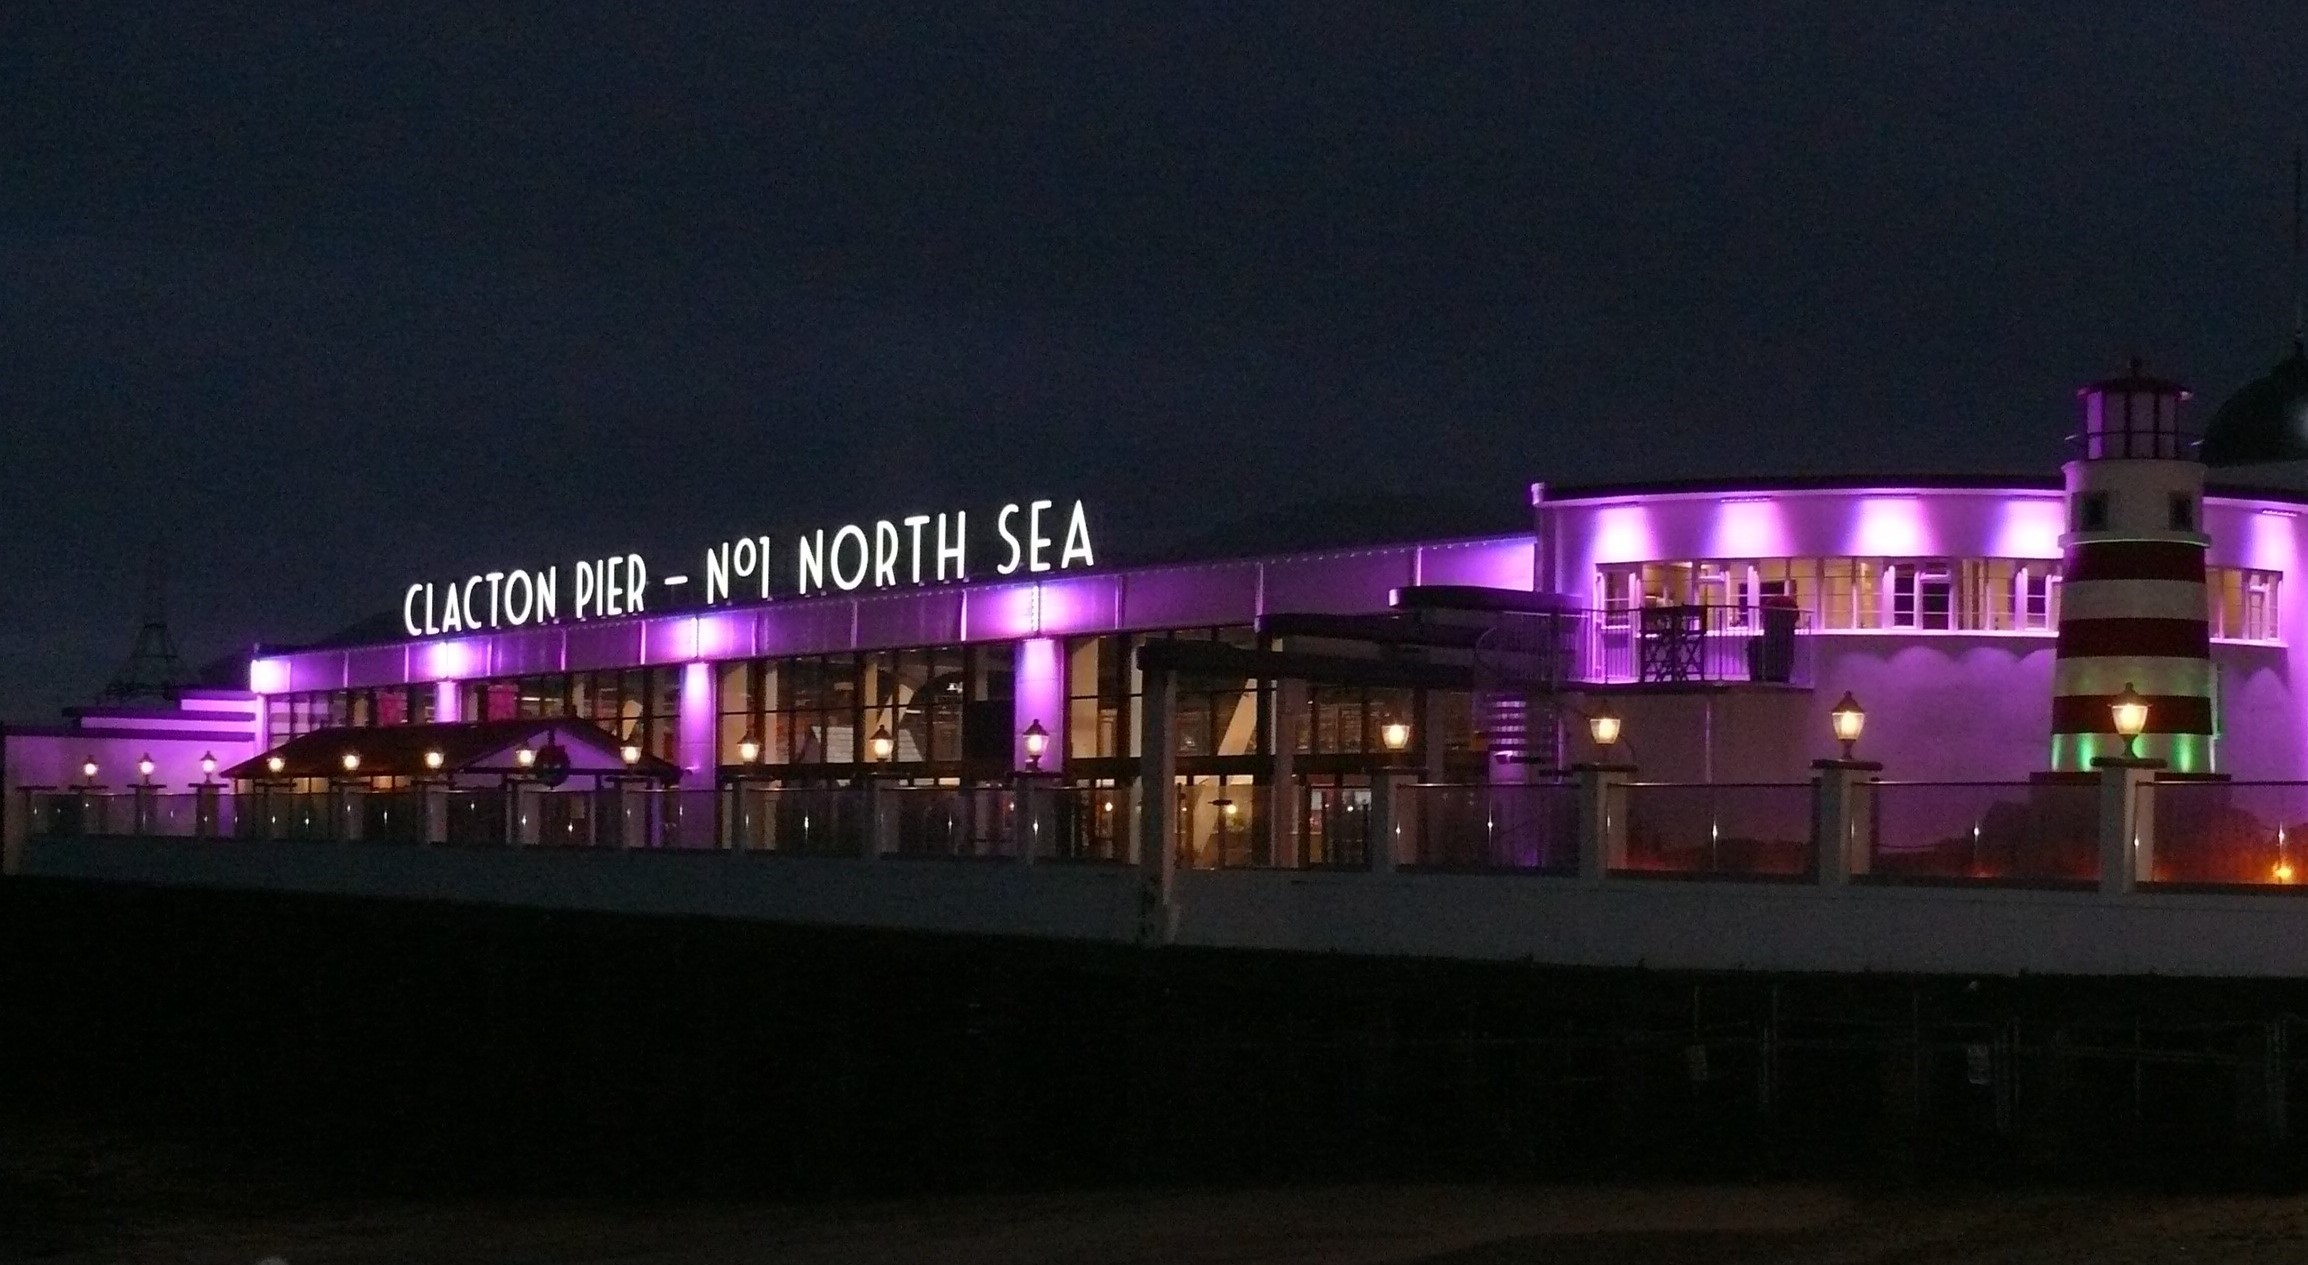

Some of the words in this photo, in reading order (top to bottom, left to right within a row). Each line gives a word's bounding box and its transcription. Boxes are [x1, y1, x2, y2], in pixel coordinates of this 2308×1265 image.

[404, 564, 558, 637] CLACTON
[574, 553, 647, 622] PIER
[799, 510, 967, 595] NORTH
[996, 499, 1095, 575] SEA
